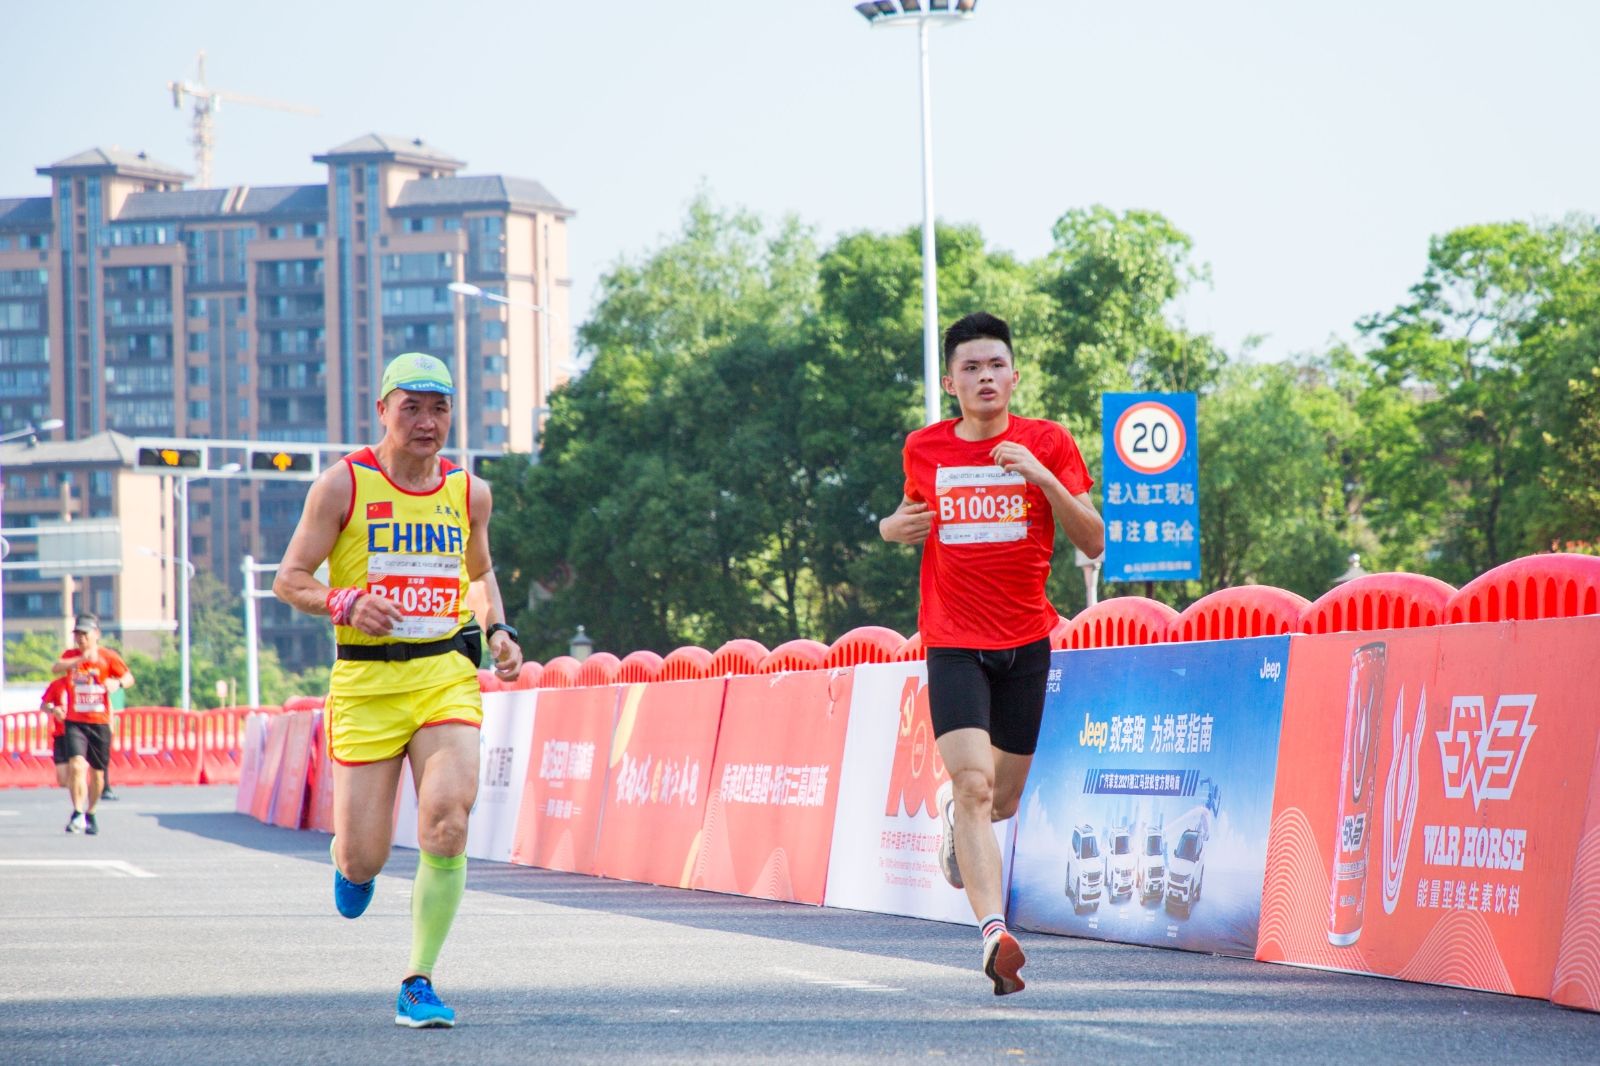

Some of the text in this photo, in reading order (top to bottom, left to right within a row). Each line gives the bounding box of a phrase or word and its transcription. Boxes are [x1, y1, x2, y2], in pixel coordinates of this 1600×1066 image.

[1132, 422, 1168, 453] 20
[939, 495, 1024, 520] B10038
[1107, 482, 1194, 505] 进入施工现场
[367, 522, 463, 553] CHINA
[1108, 520, 1194, 543] 请注意安全
[1260, 657, 1281, 682] Jeep
[1079, 713, 1214, 753] Jeep 致奔跑 为热爱指南
[1423, 825, 1528, 871] WAR HORSE
[1416, 877, 1520, 916] 能量型维生素饮料
